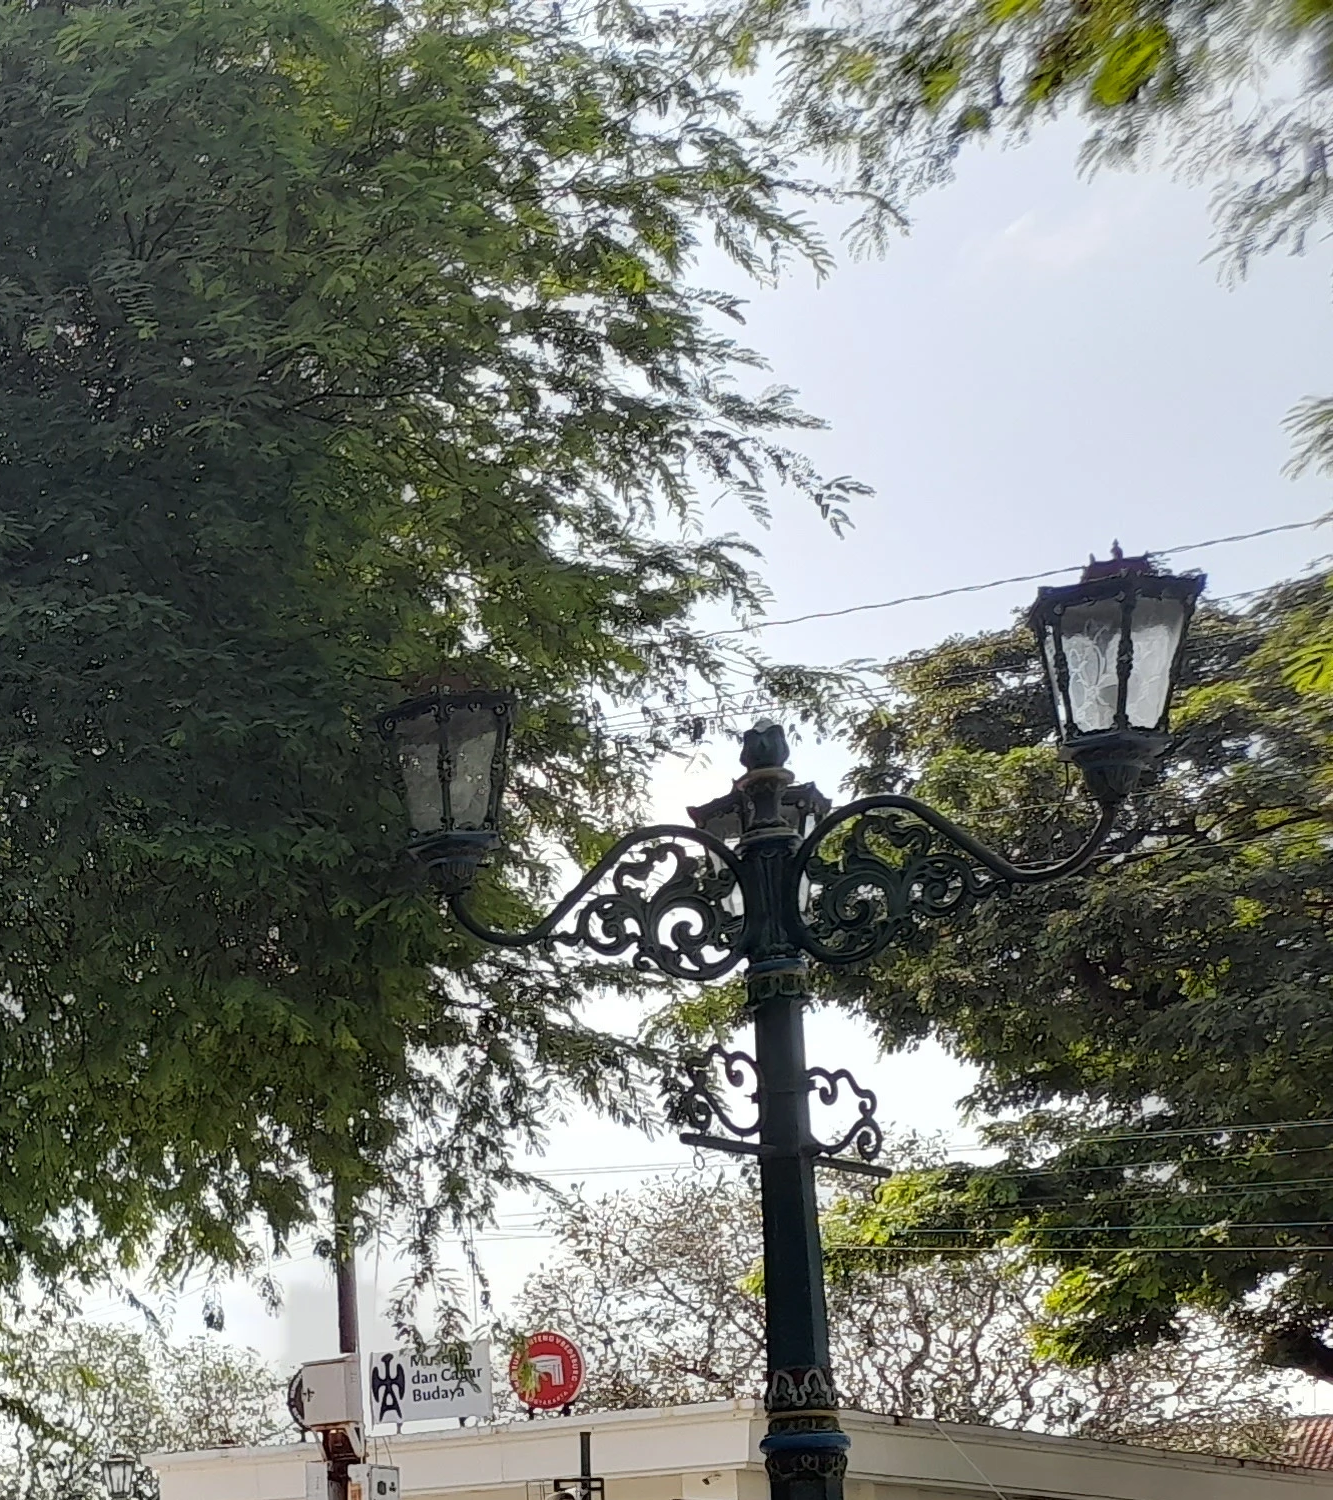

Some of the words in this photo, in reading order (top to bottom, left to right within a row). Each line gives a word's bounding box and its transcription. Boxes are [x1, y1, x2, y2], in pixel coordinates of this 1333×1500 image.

[410, 1352, 472, 1368] Musem
[411, 1370, 437, 1385] dan
[412, 1385, 465, 1402] Budaya
